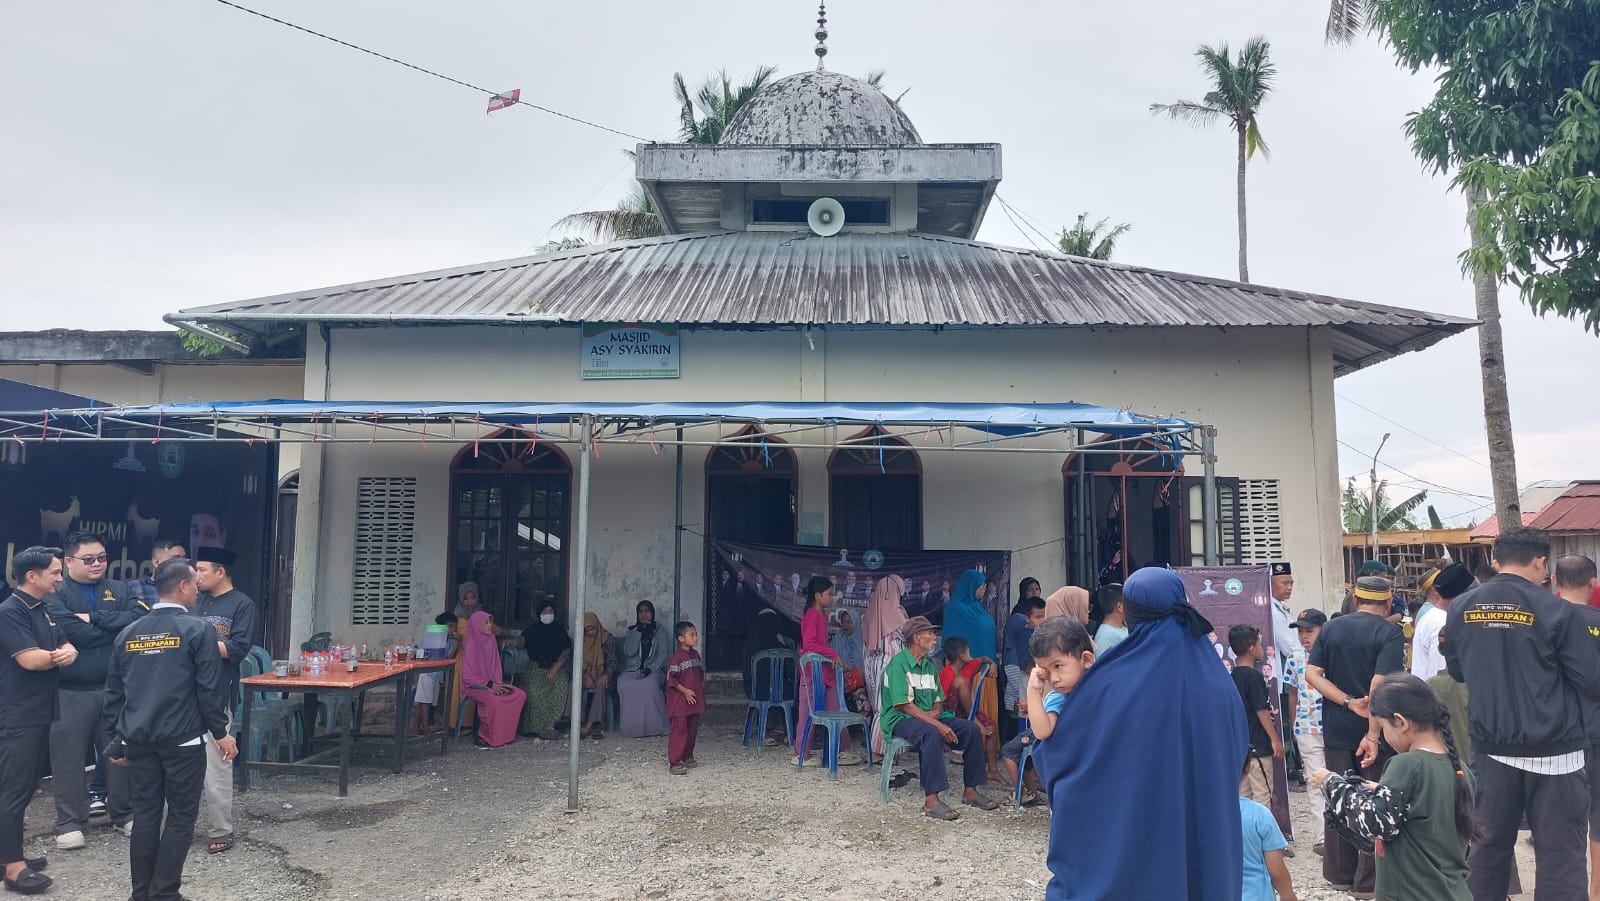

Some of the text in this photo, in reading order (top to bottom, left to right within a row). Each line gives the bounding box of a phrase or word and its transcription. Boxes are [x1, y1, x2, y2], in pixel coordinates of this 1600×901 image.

[610, 331, 650, 343] MASJID
[590, 344, 671, 355] ASY SYAKIRIN
[79, 520, 127, 542] HIPMI
[842, 599, 870, 607] HIPMI
[1469, 612, 1527, 622] BALIKPAPAN
[130, 639, 175, 649] BALIKPAPAN
